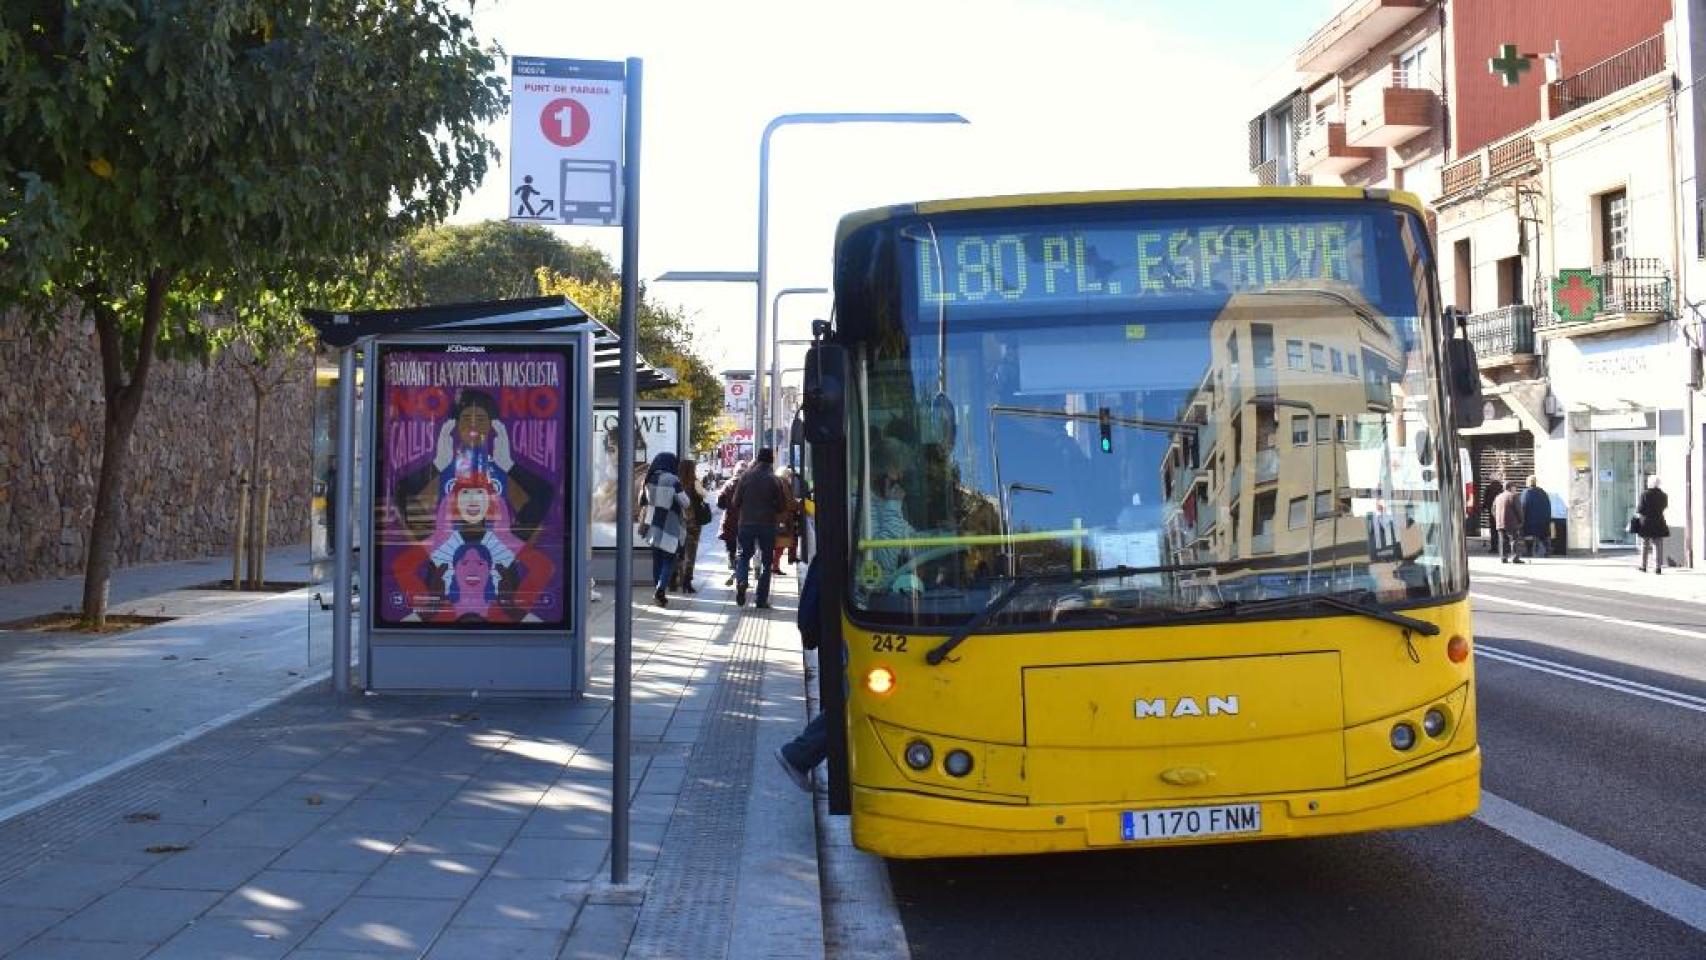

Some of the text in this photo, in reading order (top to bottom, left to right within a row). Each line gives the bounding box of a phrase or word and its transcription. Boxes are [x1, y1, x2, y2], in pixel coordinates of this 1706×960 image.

[524, 83, 610, 95] PUNT DE PARADA
[554, 106, 573, 138] 1
[919, 225, 1349, 302] L80 PL. ESPANYA
[434, 361, 447, 386] LA
[390, 386, 560, 418] NO NO
[872, 634, 908, 653] 242
[1134, 694, 1240, 719] MAN
[1142, 810, 1200, 836] 1170
[1209, 806, 1256, 832] FNM
